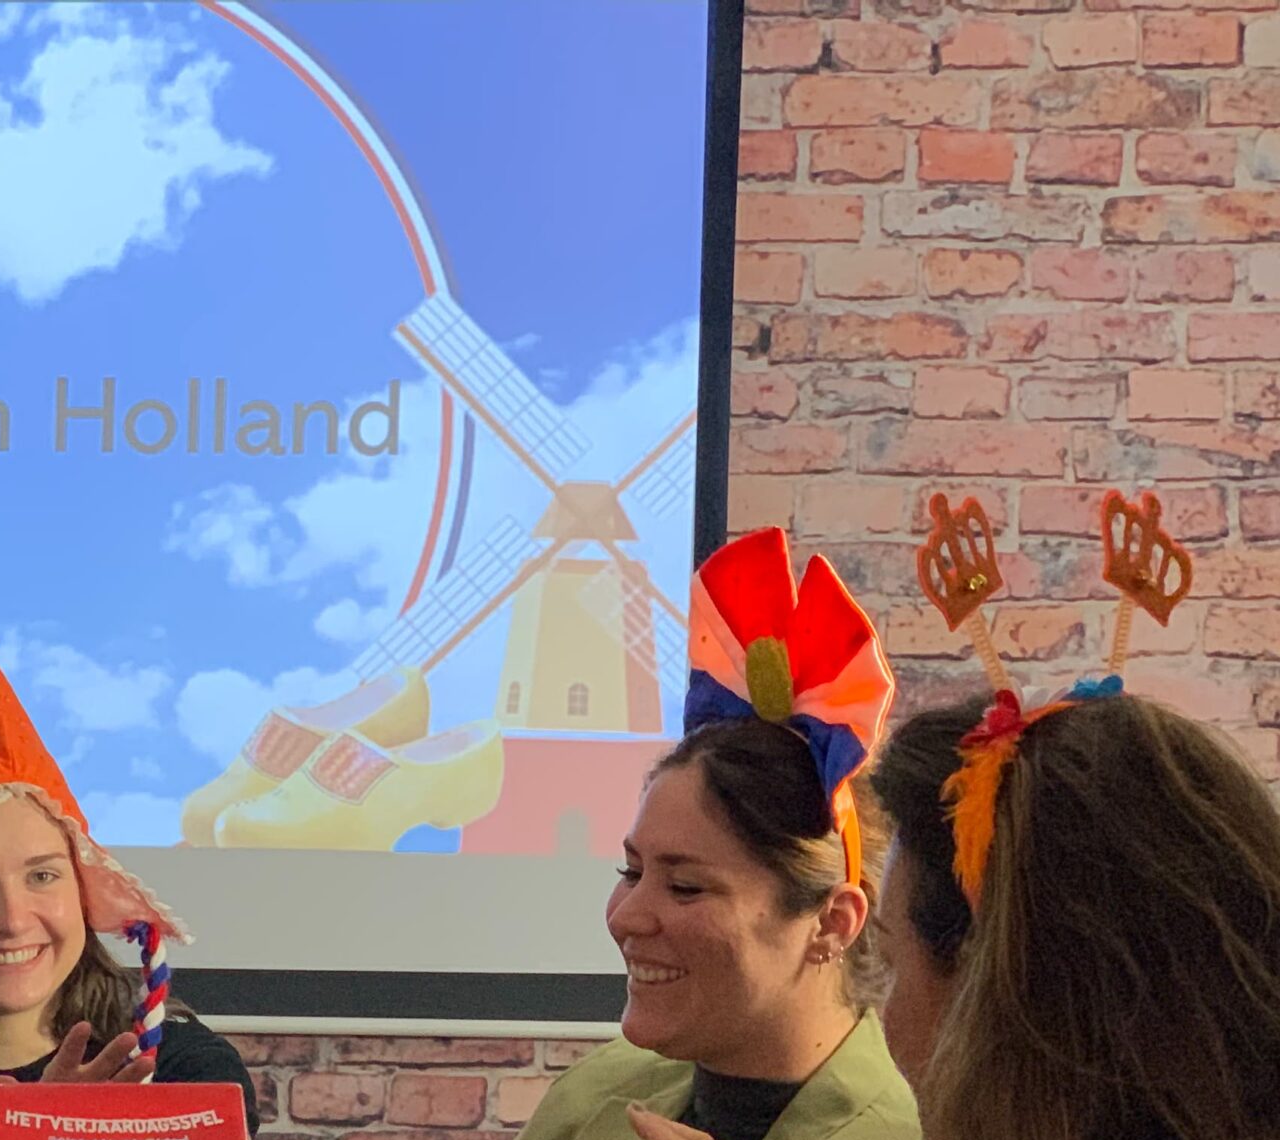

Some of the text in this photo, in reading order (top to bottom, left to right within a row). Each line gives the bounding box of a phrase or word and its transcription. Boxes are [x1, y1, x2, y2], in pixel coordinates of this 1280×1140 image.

[54, 376, 402, 457] Holland
[5, 1109, 225, 1134] HET VERJAARDAGSSPEL
